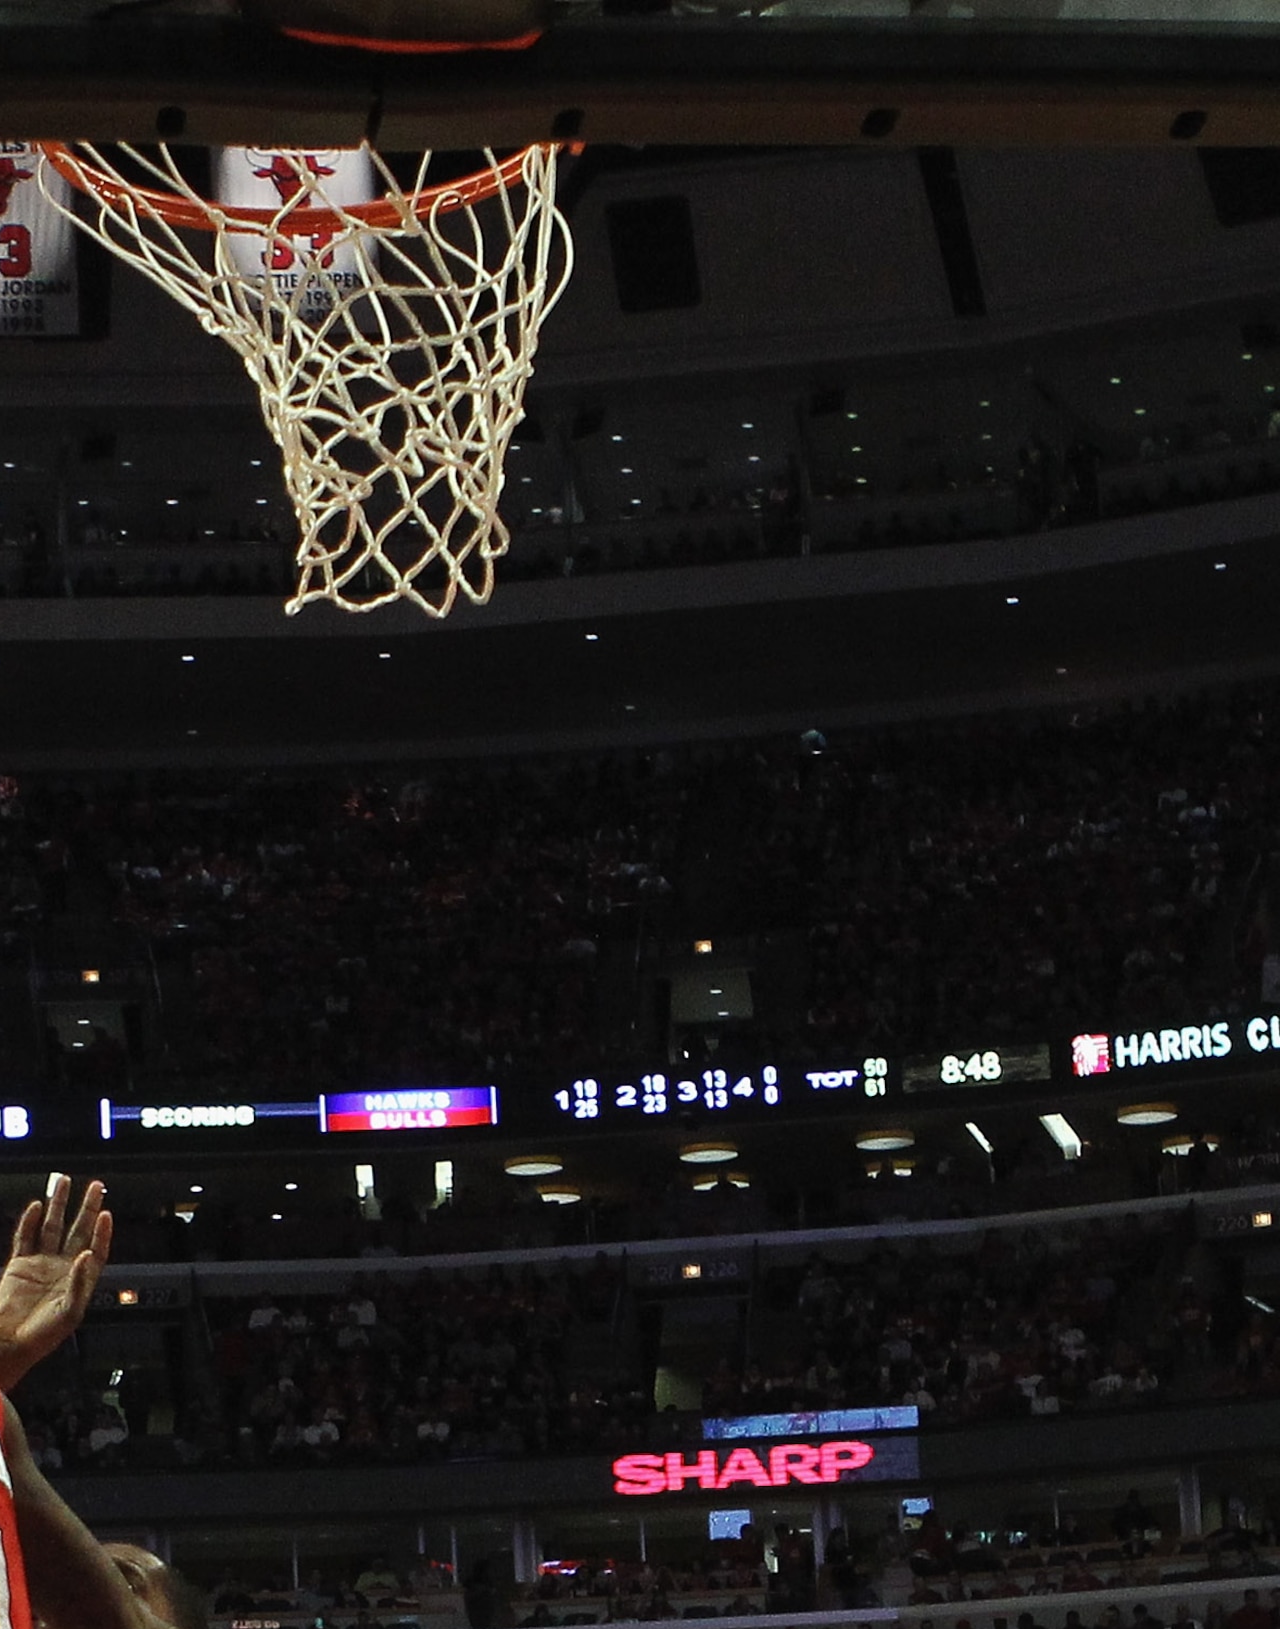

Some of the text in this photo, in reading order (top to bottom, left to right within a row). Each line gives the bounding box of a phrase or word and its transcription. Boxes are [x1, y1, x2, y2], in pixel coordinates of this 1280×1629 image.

[1, 280, 69, 296] JORDAN
[1114, 1022, 1232, 1068] HARRIS
[763, 1065, 777, 1084] 0
[940, 1051, 1002, 1084] 8:48
[732, 1076, 754, 1097] 4
[805, 1070, 859, 1089] TOT
[864, 1077, 887, 1096] 61
[554, 1089, 570, 1111] 1
[616, 1085, 637, 1107] 2
[677, 1080, 698, 1102] 3
[763, 1085, 778, 1104] 0
[365, 1092, 451, 1112] HAWKS
[141, 1105, 255, 1128] SCORING
[369, 1110, 447, 1129] BULLS
[612, 1440, 875, 1495] SHARP
